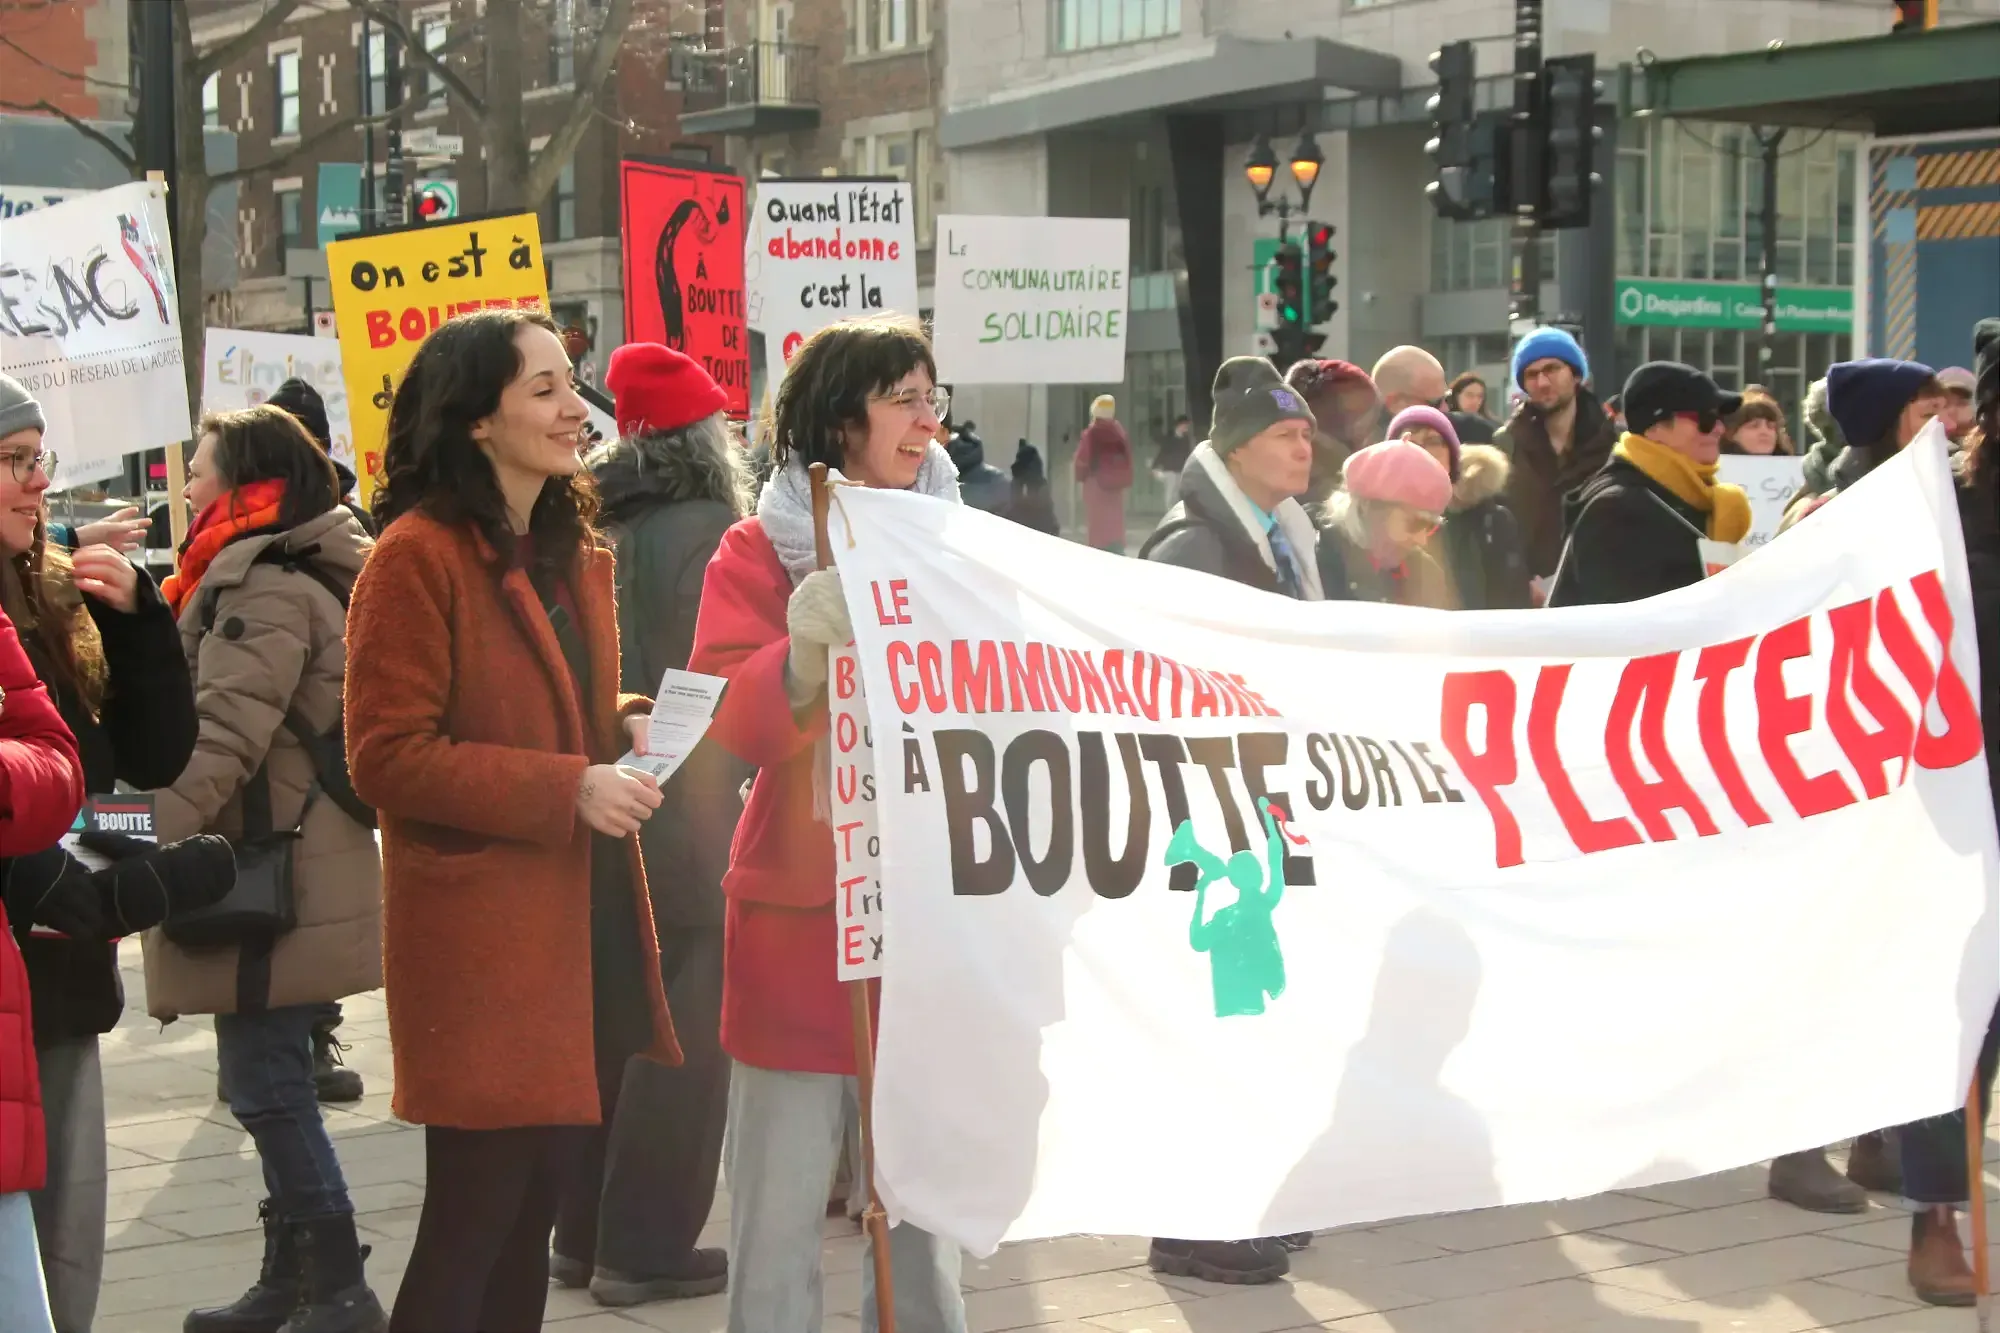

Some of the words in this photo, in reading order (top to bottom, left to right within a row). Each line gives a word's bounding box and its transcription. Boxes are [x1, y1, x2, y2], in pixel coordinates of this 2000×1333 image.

[767, 192, 841, 223] Quand
[849, 186, 904, 224] l'État
[351, 260, 405, 292] On
[421, 231, 487, 283] est
[508, 234, 533, 270] à
[768, 227, 900, 261] abandonne
[800, 273, 850, 308] c'est
[860, 273, 883, 309] la
[962, 265, 1122, 292] COMMUNAUTAIRE
[687, 284, 744, 319] BOUTTE
[1645, 293, 1722, 317] Desjardins
[722, 324, 740, 350] DE
[979, 306, 1122, 343] SOLIDAIRE
[43, 372, 66, 389] DU
[70, 361, 119, 385] RÉSEAU
[122, 357, 138, 375] DE
[217, 345, 342, 386] Élimine
[702, 355, 748, 389] TOUTE
[870, 579, 913, 626] LE
[886, 638, 1284, 722] COMMUNAUTAIRE
[902, 722, 930, 793] À
[933, 728, 1316, 900] BOUTTE
[1306, 732, 1402, 811] SUR
[1388, 739, 1466, 803] LE
[1441, 569, 1984, 868] PLATEAU
[99, 812, 152, 831] BOUTTE
